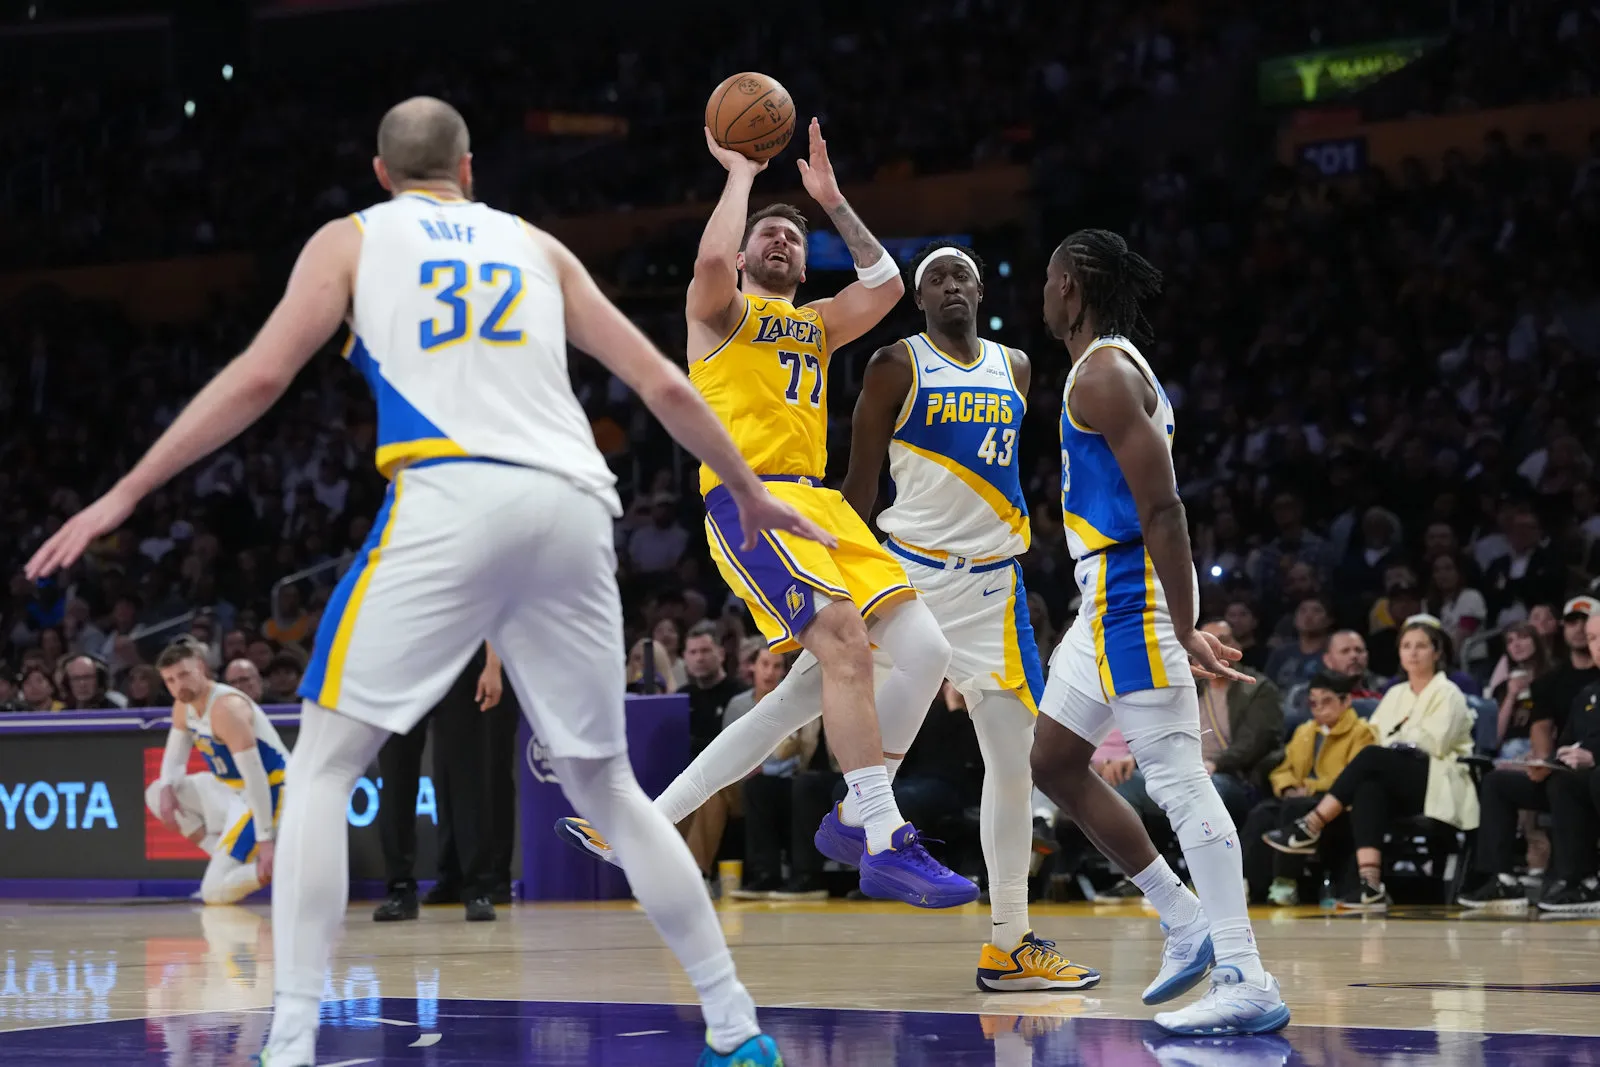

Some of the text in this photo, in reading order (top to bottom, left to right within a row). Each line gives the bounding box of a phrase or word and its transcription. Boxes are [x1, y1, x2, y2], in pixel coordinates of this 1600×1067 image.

[419, 259, 527, 353] 32
[777, 350, 823, 408] 77
[925, 391, 1013, 426] PACERS
[977, 427, 1016, 467] 43
[0, 780, 119, 830] YOTA
